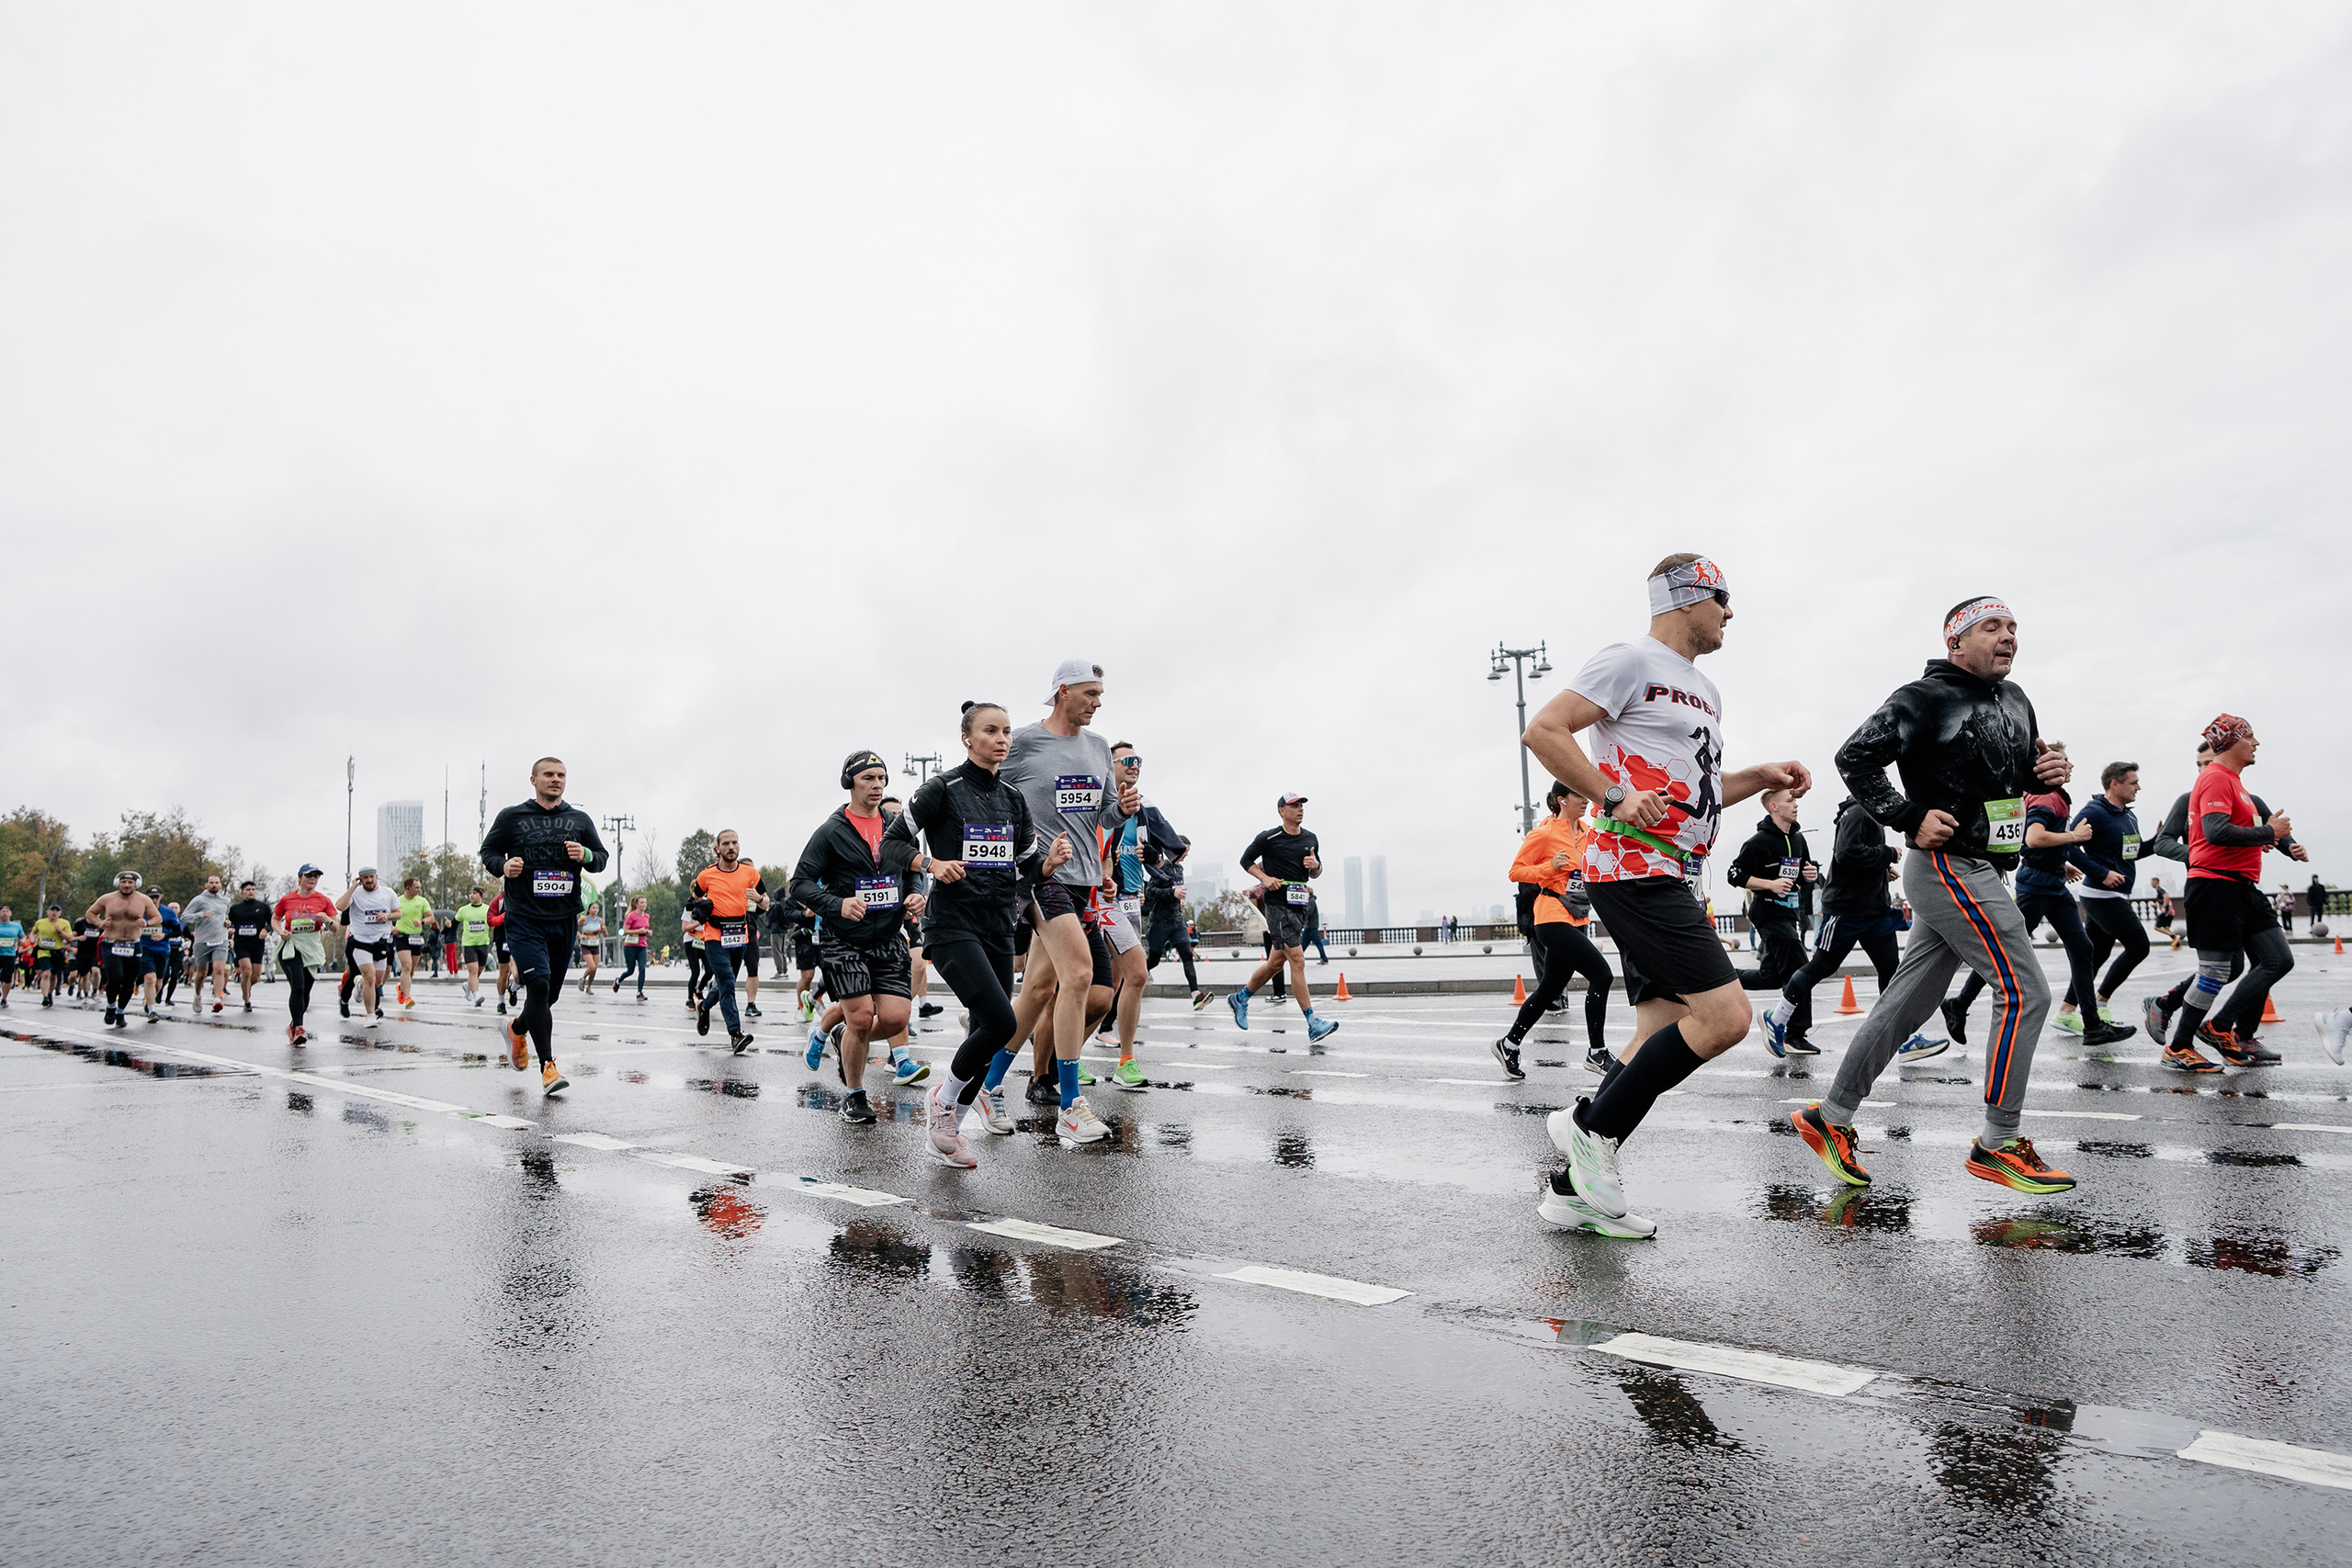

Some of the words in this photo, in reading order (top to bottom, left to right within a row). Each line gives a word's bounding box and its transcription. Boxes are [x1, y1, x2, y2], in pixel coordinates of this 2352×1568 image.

[1060, 793, 1091, 804] 5954
[518, 817, 574, 832] BLOOD
[1996, 822, 2023, 840] 436
[525, 846, 567, 861] RESPEC
[968, 844, 1006, 857] 5948
[537, 883, 566, 891] 5904
[864, 892, 888, 902] 5191
[723, 936, 741, 944] 5842
[1993, 1151, 2026, 1174] HEAD
